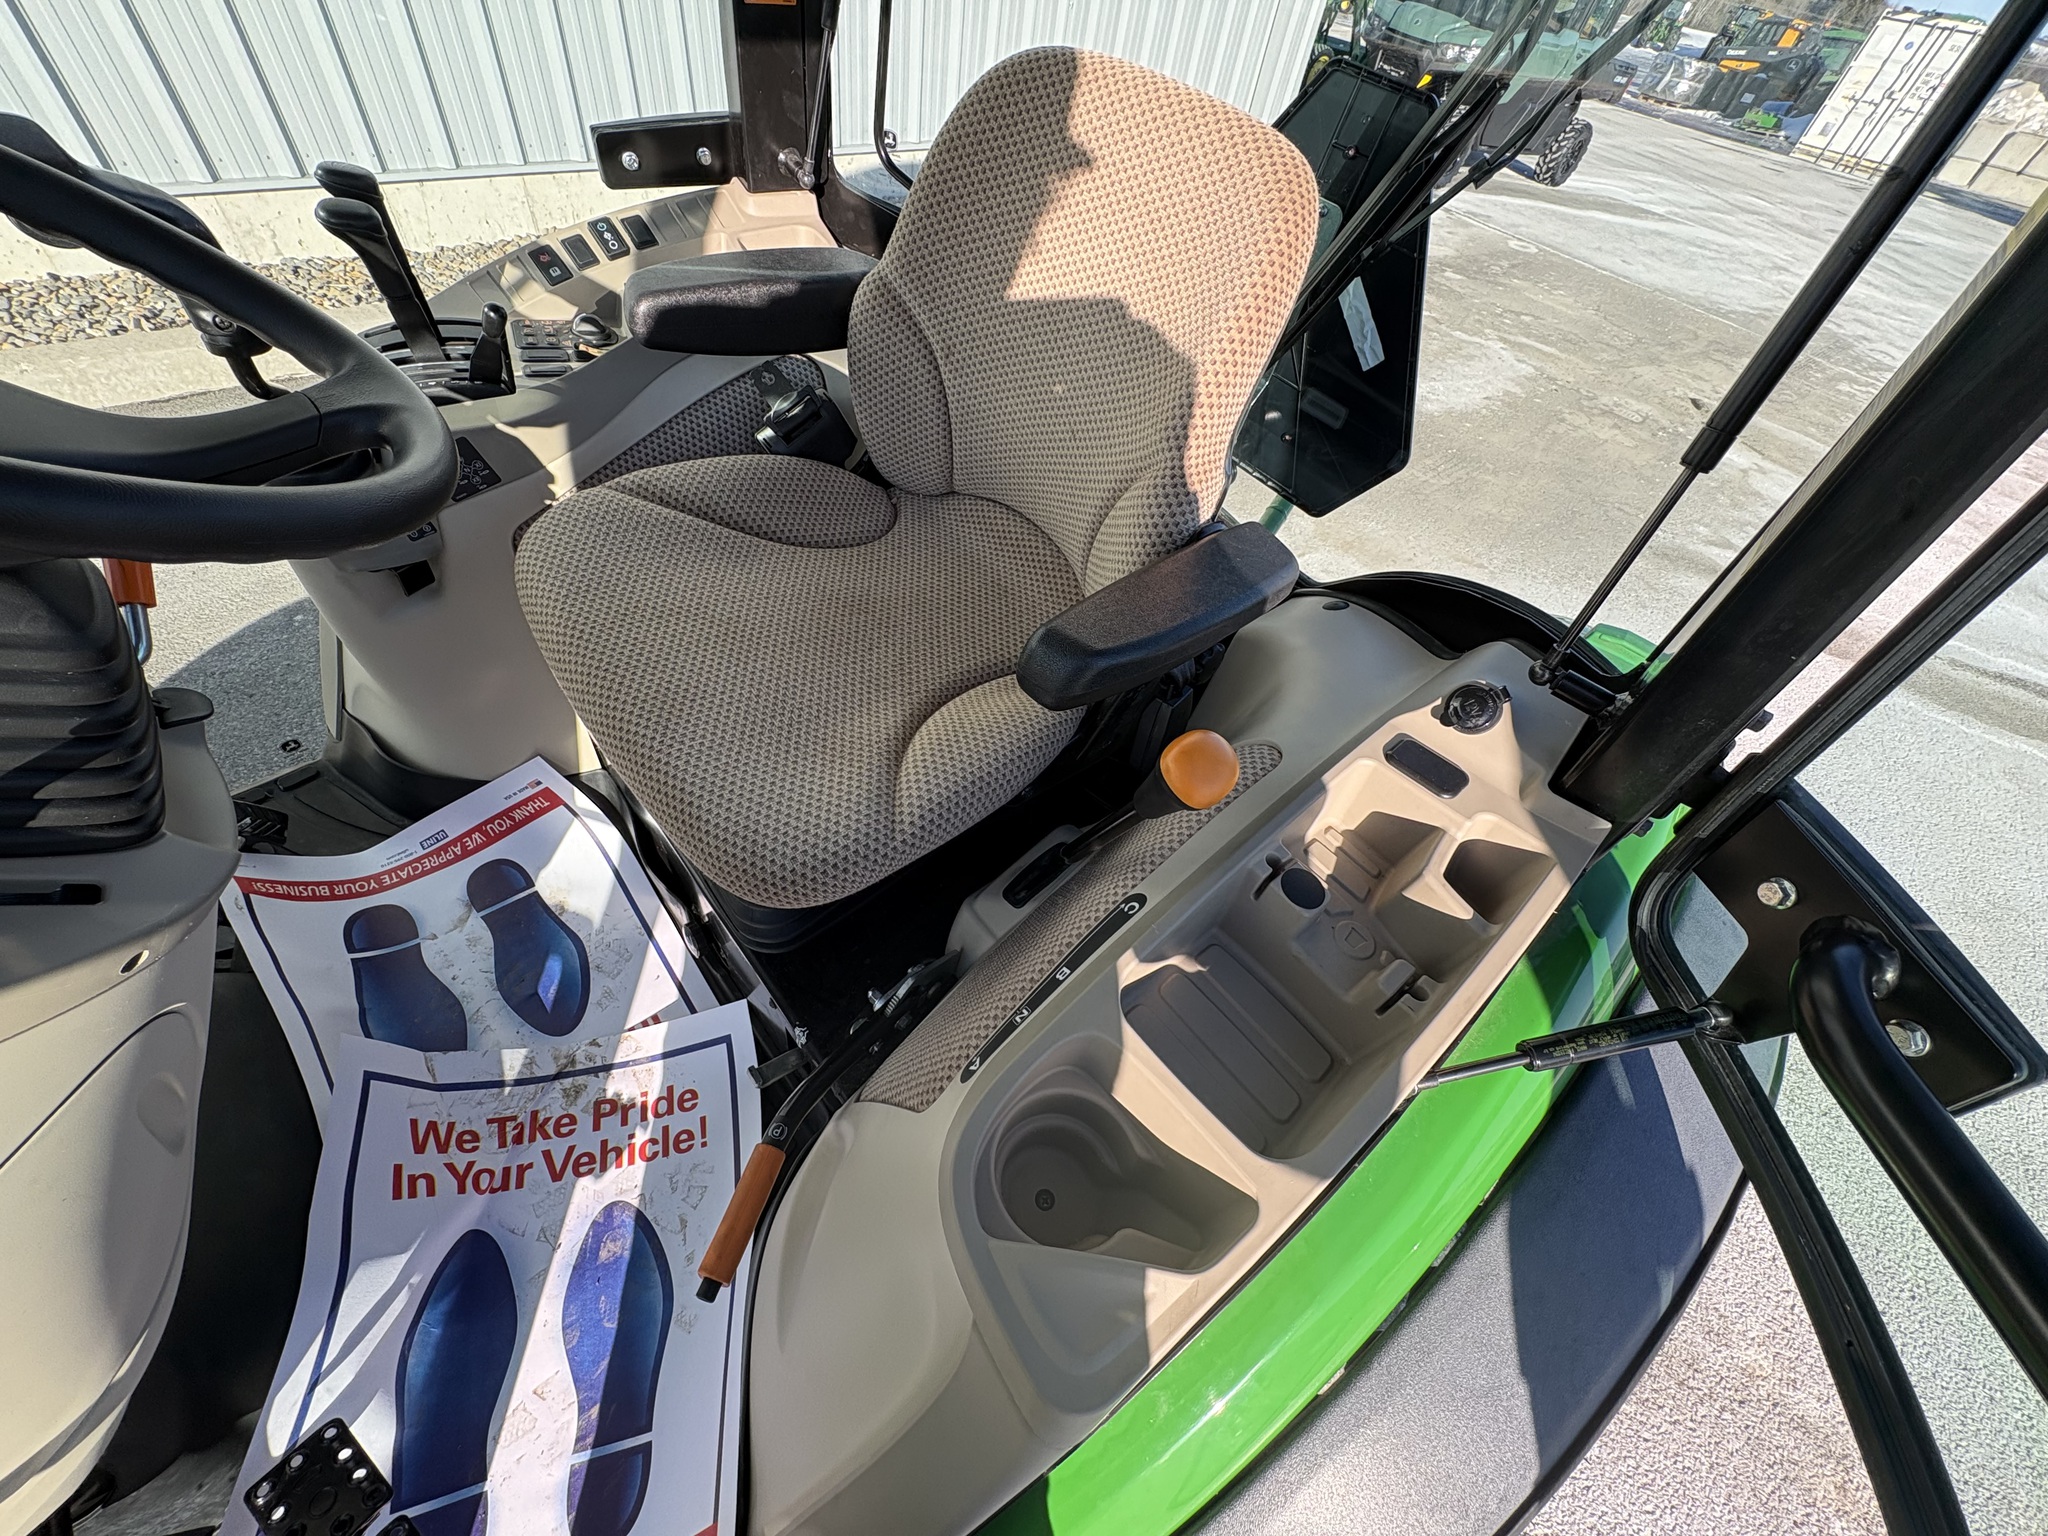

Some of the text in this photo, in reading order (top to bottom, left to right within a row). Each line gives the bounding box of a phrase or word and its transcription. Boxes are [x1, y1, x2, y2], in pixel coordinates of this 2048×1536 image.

[252, 796, 551, 897] THANK YOU, WE APPRECIATE YOUR BUSINESS!
[420, 830, 448, 850] ULINE
[969, 901, 1140, 1071] C B N A
[391, 1115, 709, 1201] In Your Vehicle!
[409, 1084, 700, 1156] We Take Pride
